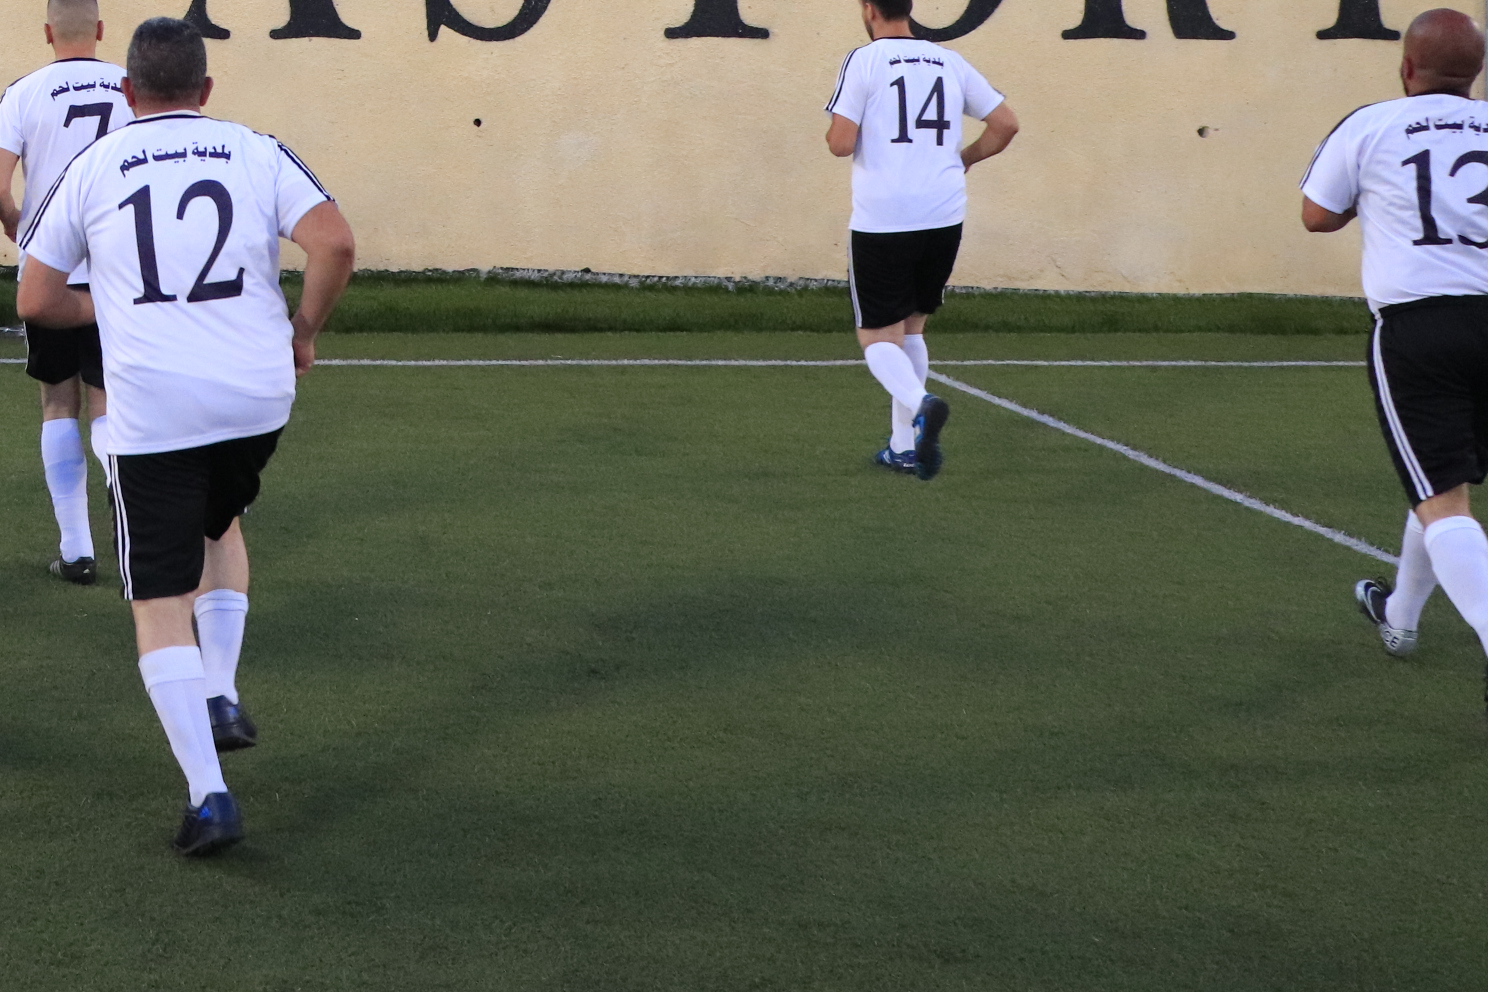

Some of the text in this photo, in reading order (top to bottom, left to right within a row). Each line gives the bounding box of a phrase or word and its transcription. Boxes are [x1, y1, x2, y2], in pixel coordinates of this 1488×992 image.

[50, 81, 70, 101] لحم
[72, 80, 96, 93] بيت
[63, 101, 114, 141] 7
[890, 75, 951, 146] 14
[1405, 116, 1431, 140] لحم
[1434, 118, 1464, 134] بيت
[119, 141, 231, 178] بلدية بيت لحم
[1401, 148, 1488, 250] 13
[118, 178, 246, 305] 12
